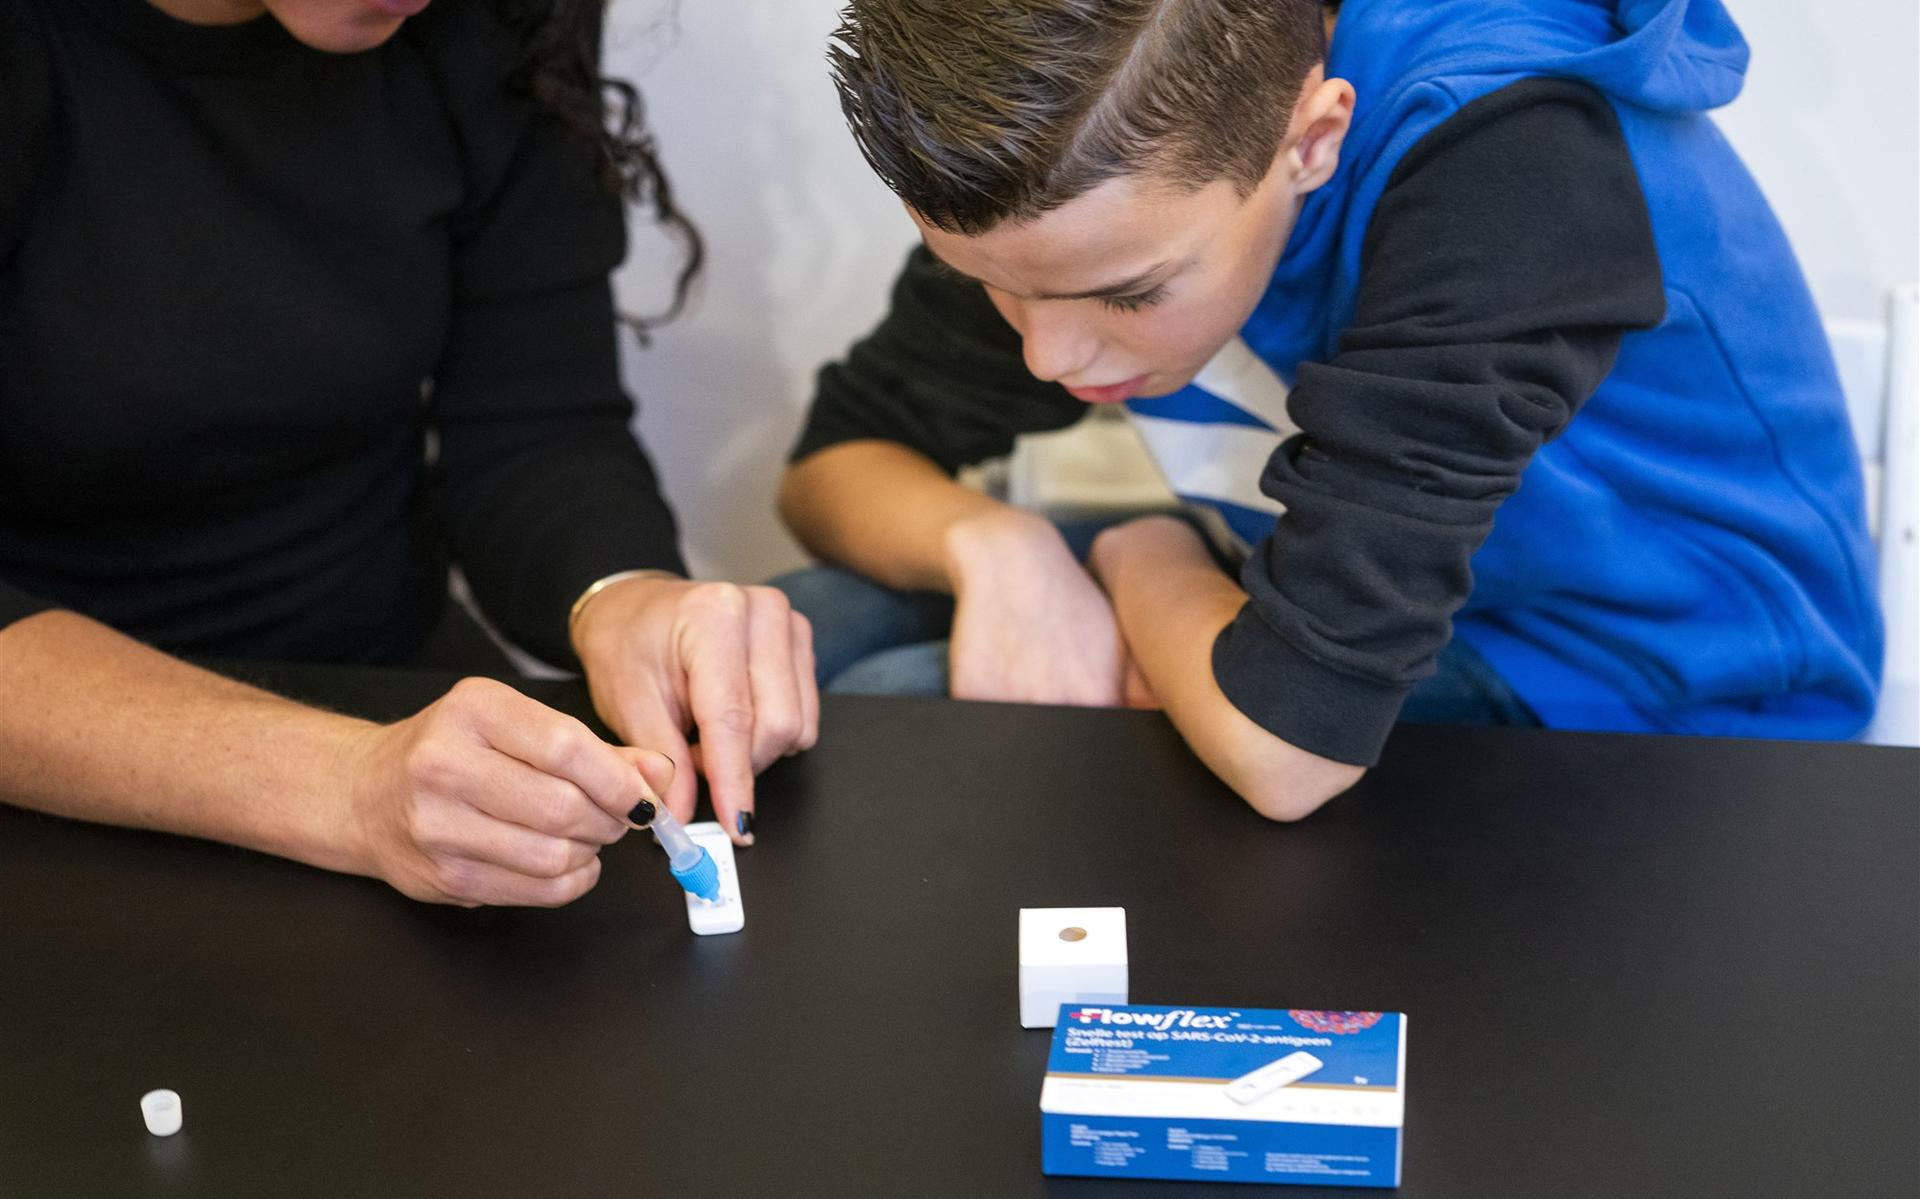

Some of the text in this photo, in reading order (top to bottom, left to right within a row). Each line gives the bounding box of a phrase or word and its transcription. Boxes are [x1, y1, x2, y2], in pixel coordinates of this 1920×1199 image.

[1073, 1008, 1231, 1031] Flowflex
[1067, 1027, 1114, 1039] Snelle
[1116, 1030, 1144, 1040] test
[1146, 1032, 1169, 1041] op
